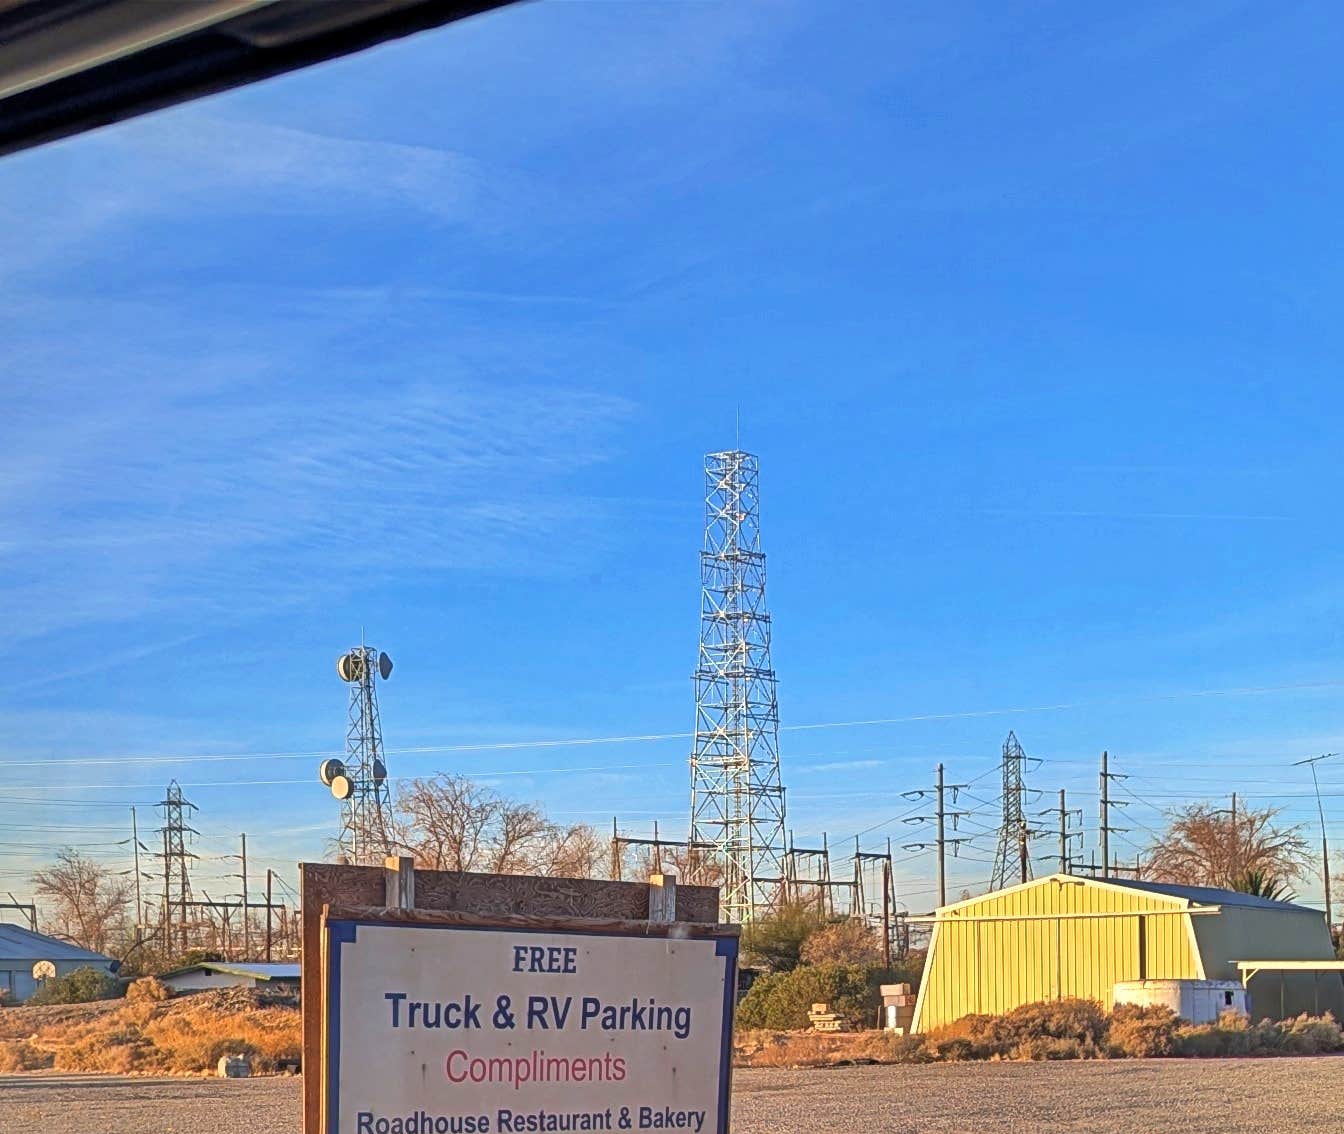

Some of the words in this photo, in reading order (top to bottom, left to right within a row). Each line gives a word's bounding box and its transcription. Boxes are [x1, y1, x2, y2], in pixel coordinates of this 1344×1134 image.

[512, 945, 577, 974] FREE
[384, 992, 481, 1029] Truck
[492, 995, 516, 1029] &
[527, 996, 573, 1029] RV
[581, 997, 692, 1039] Parking
[445, 1050, 626, 1089] Compliments
[497, 1108, 612, 1133] Restaurant
[618, 1107, 632, 1129] &
[639, 1106, 706, 1133] Bakery
